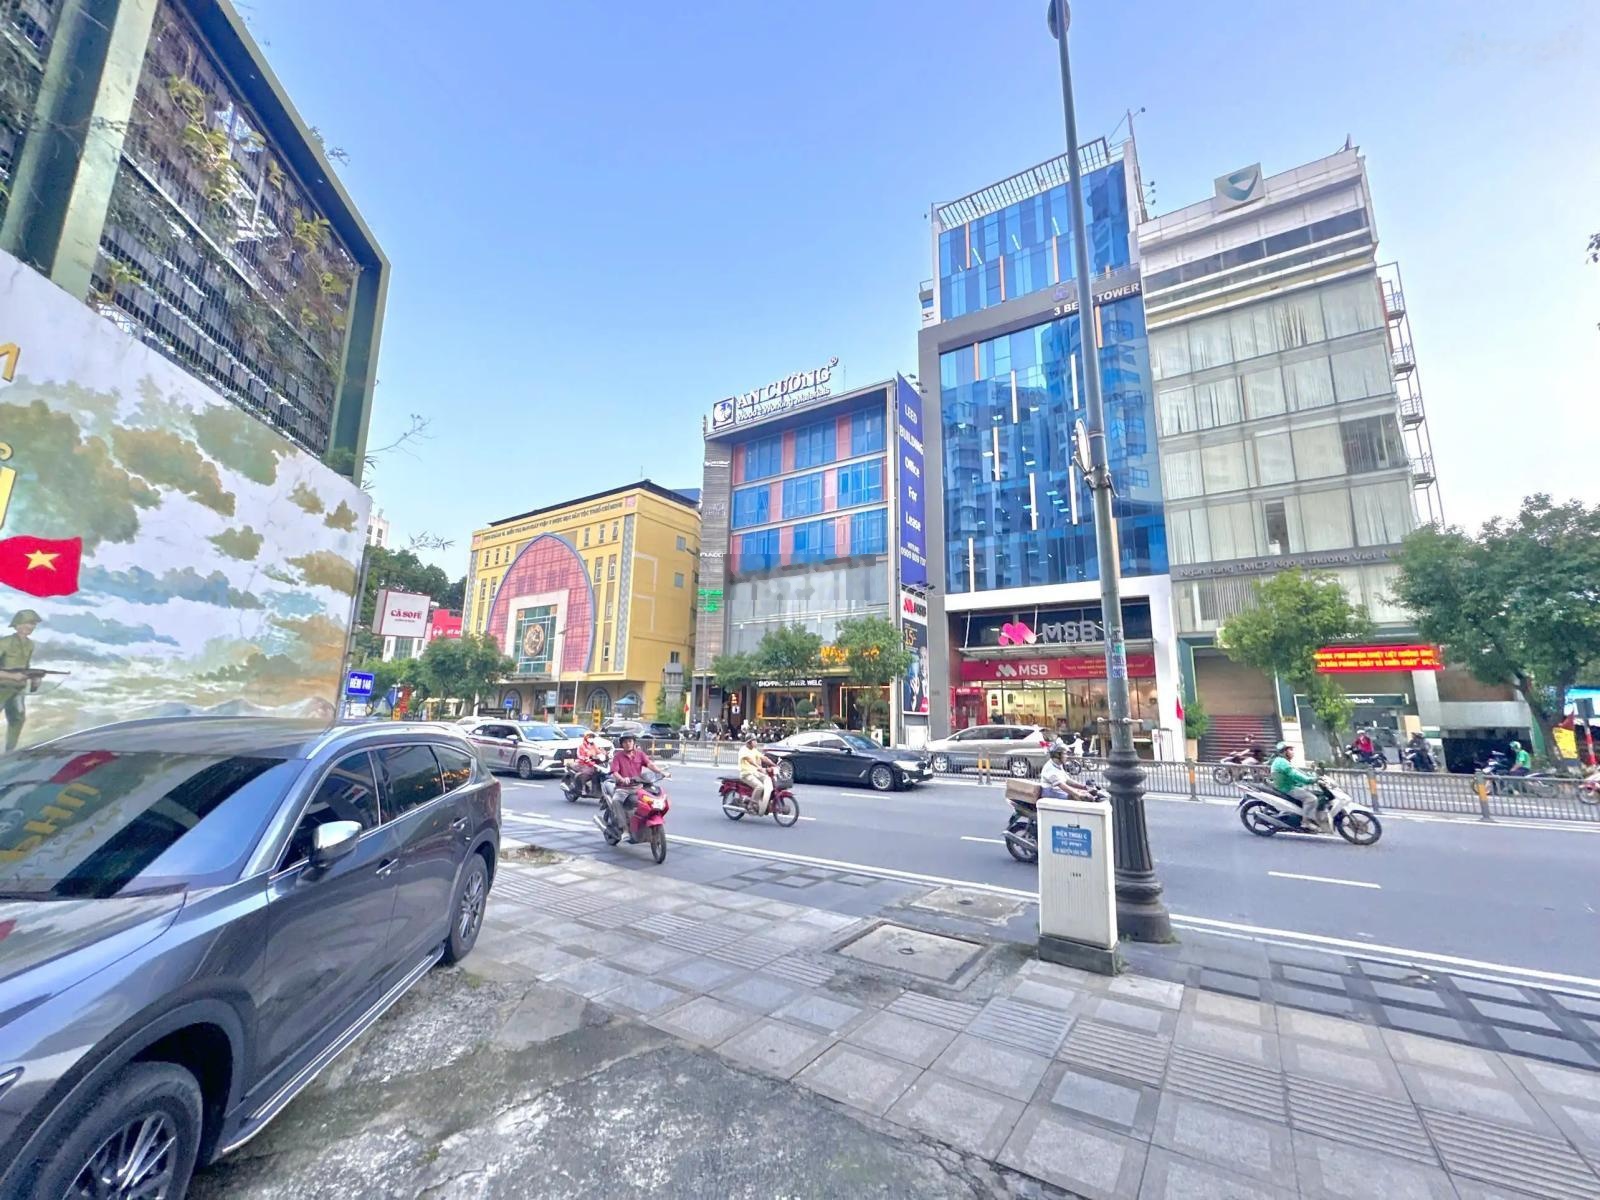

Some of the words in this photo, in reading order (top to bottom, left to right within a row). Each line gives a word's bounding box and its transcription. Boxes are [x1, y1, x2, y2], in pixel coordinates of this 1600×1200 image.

[1053, 306, 1060, 316] 3
[1096, 282, 1140, 302] TOWER
[735, 388, 762, 409] AN
[904, 403, 918, 425] LEED
[899, 424, 924, 456] BUILDING
[904, 455, 920, 478] Office
[908, 486, 918, 502] For
[905, 511, 921, 532] Lease
[1236, 560, 1270, 571] TMCP
[1041, 620, 1097, 642] MSB
[1018, 664, 1049, 676] MSB
